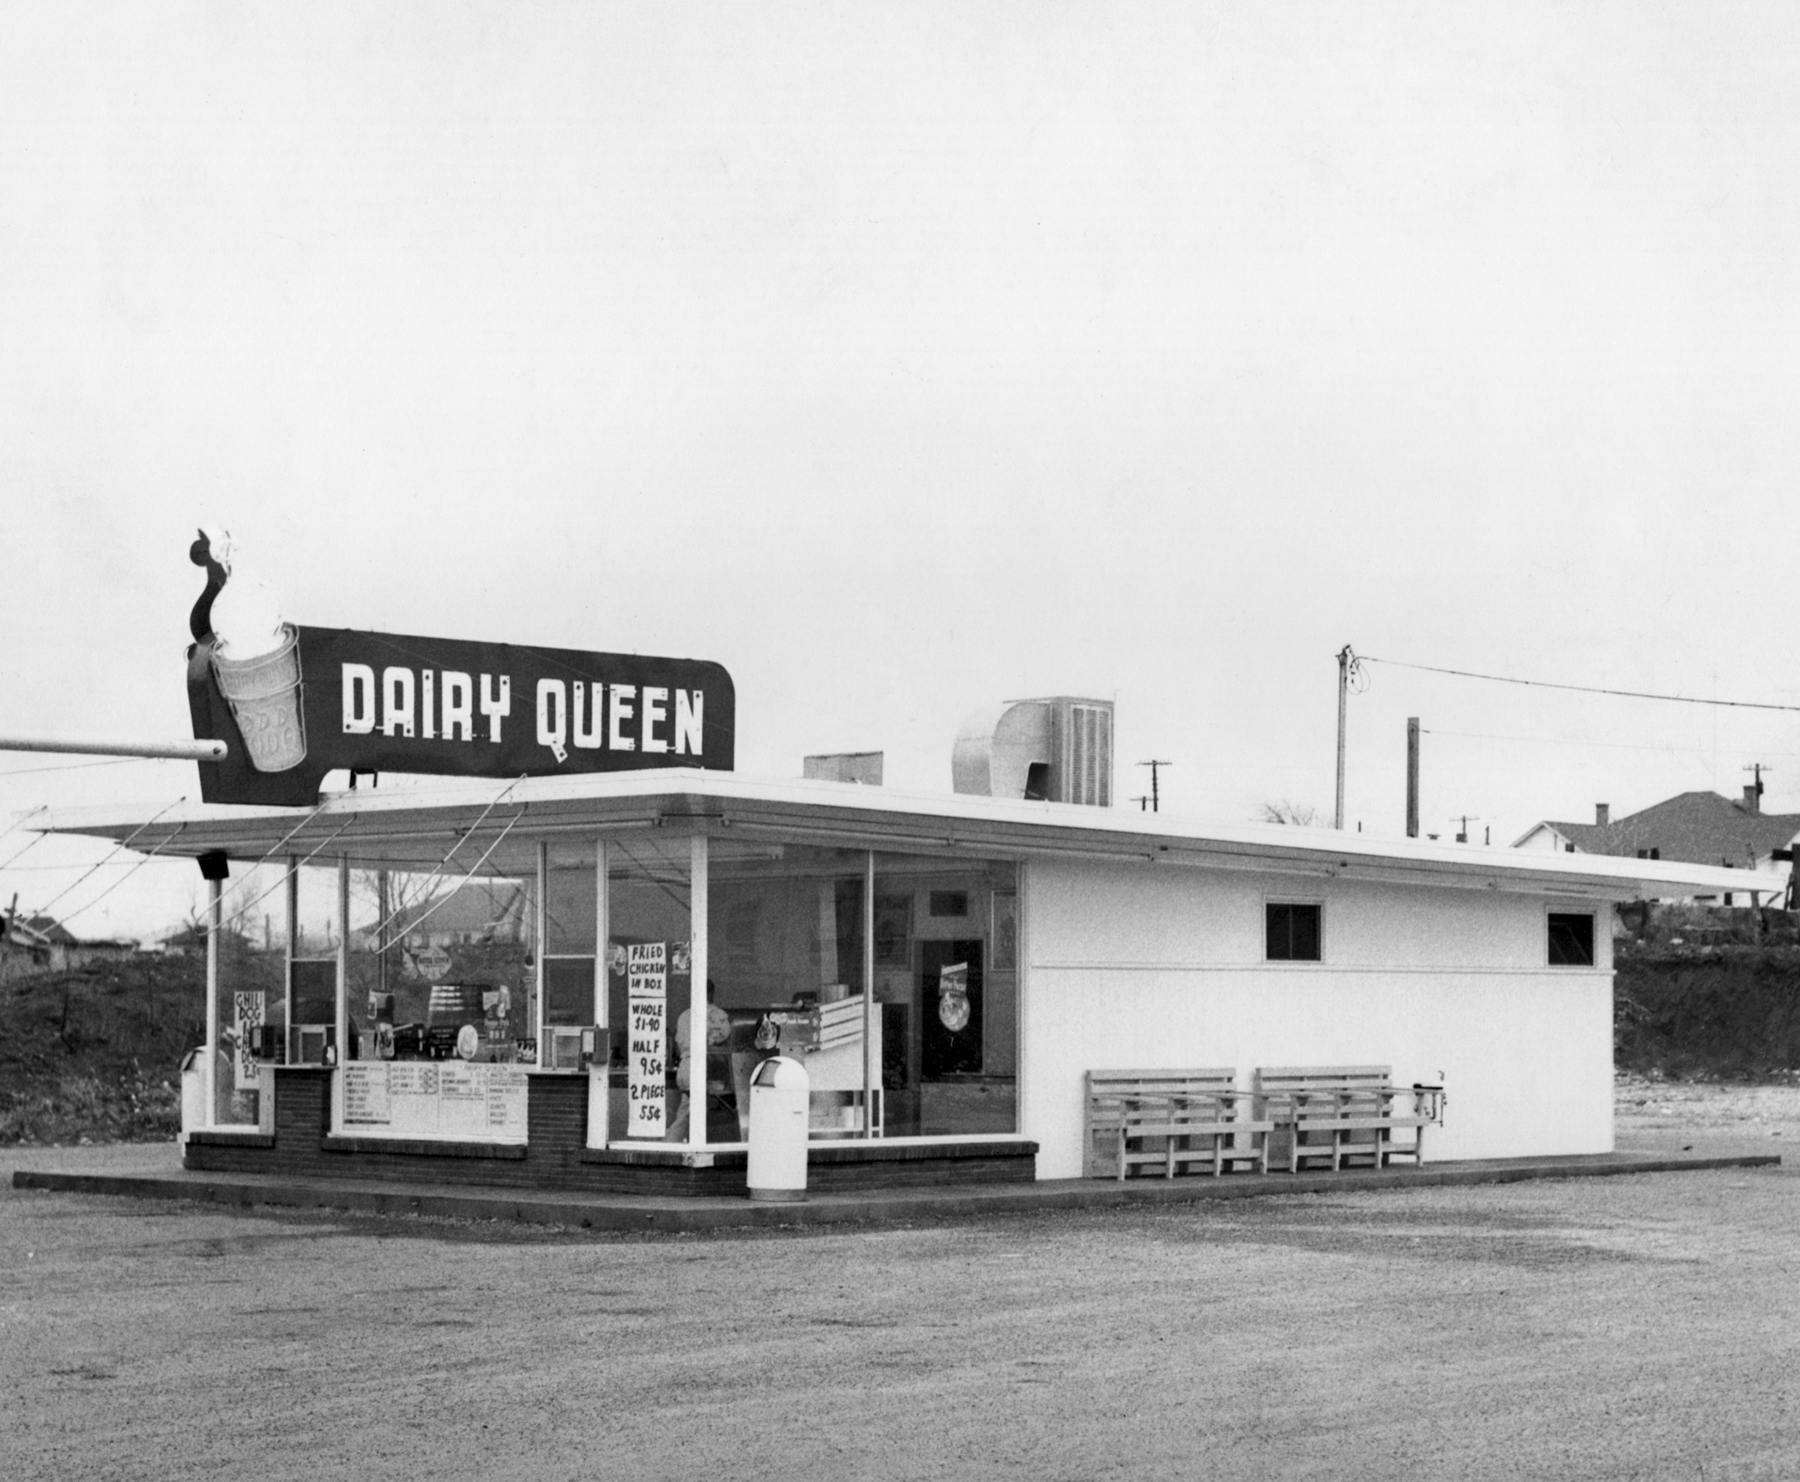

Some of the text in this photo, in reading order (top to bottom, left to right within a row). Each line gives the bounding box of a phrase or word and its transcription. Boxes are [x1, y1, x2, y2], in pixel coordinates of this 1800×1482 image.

[342, 663, 703, 763] DAIRY QUEEN
[632, 946, 664, 961] FRIED
[629, 963, 666, 976] CHICKEN
[631, 978, 662, 990] IN BOX
[240, 1007, 262, 1021] DOG
[632, 1004, 663, 1018] WHOLE
[632, 1040, 660, 1054] HALF
[640, 1057, 663, 1076] 95¢
[630, 1084, 665, 1100] 2 PIECE
[639, 1105, 661, 1121] 55¢
